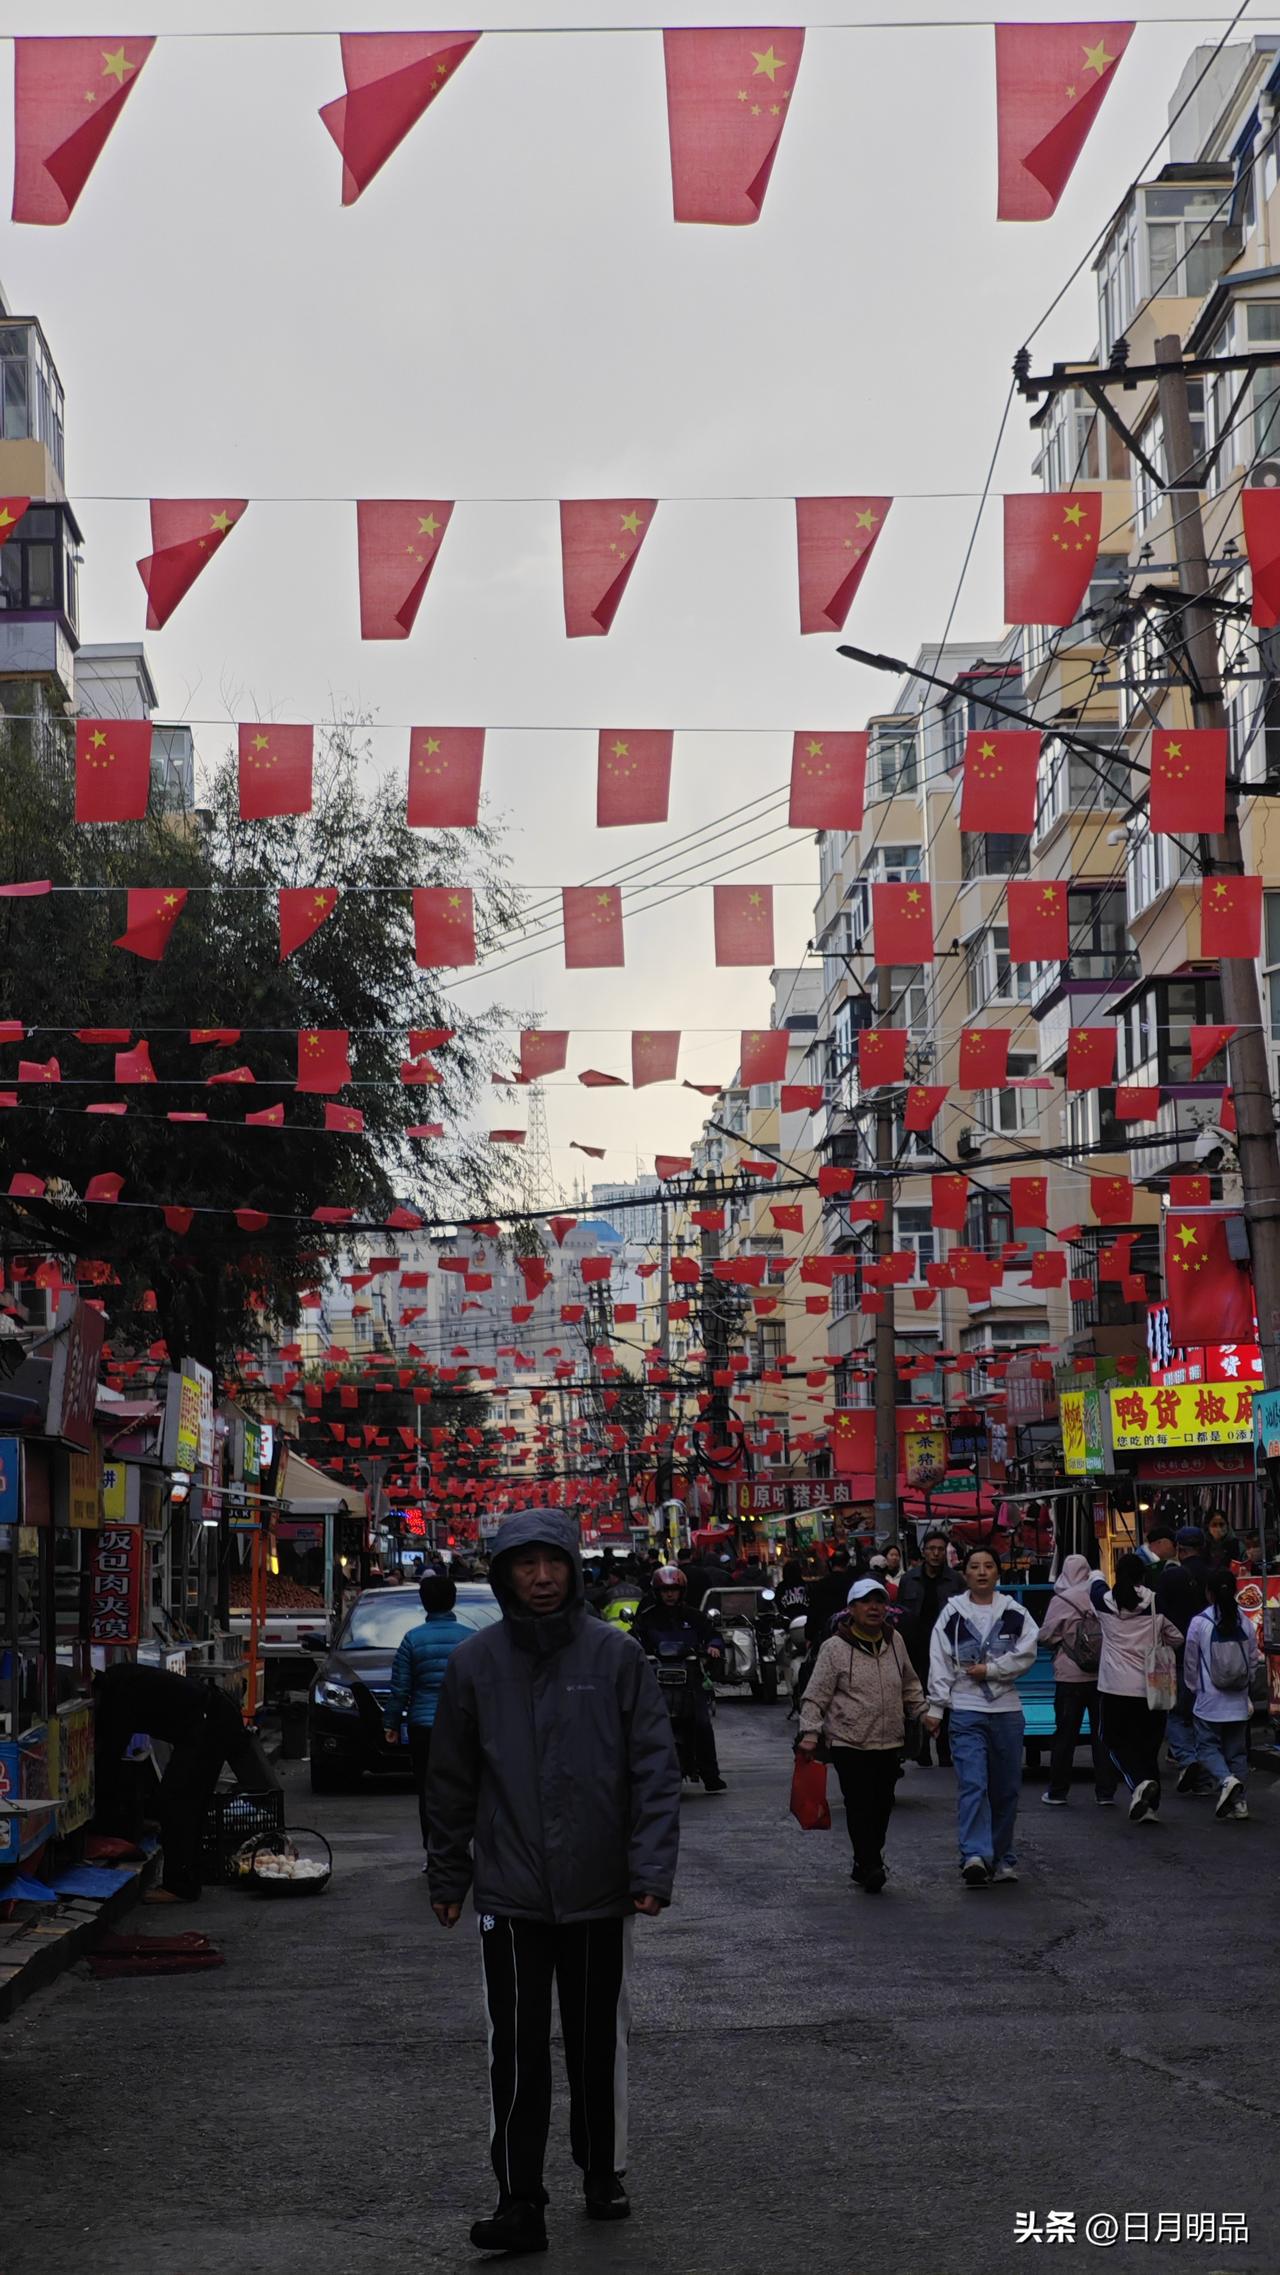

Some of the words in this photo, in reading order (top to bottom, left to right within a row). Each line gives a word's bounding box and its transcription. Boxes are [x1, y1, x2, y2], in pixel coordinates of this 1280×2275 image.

[1114, 1389, 1182, 1431] 鸭货
[753, 1482, 850, 1508] 原味猪头肉
